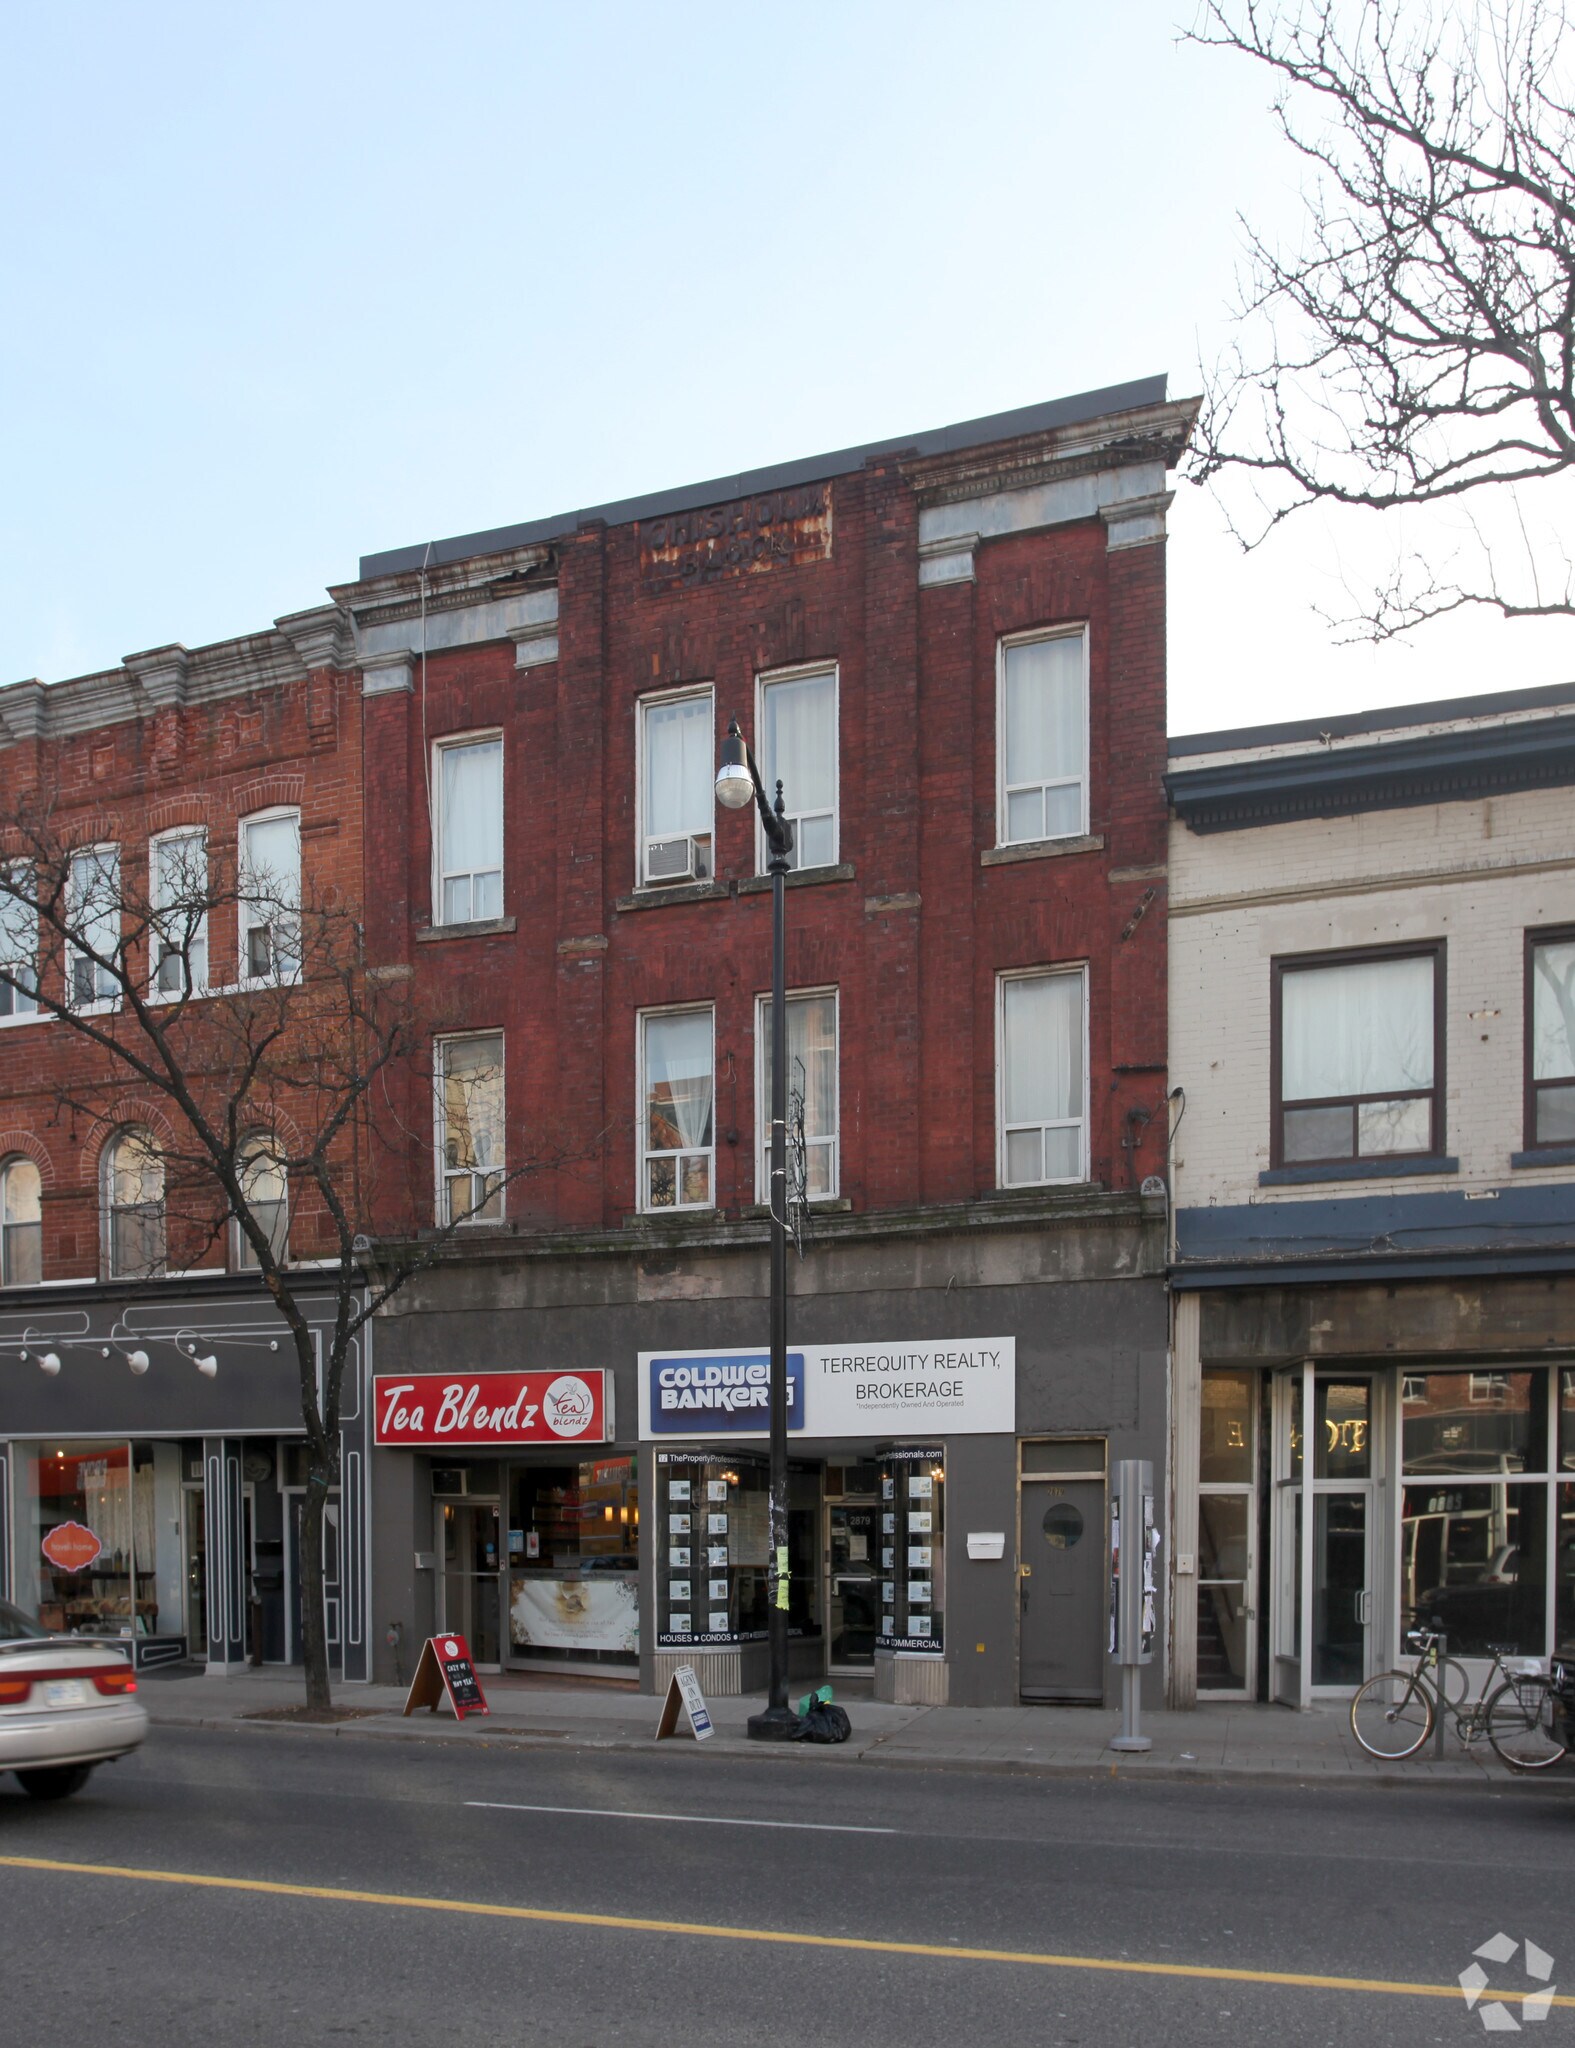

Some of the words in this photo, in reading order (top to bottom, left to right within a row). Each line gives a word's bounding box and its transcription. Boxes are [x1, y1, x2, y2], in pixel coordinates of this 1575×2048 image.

[820, 1354, 929, 1373] TERREQUITY
[934, 1351, 1001, 1370] REALTY,
[659, 1364, 795, 1388] COLDWE
[856, 1381, 964, 1400] BROKERAGE
[381, 1384, 424, 1434] Tea
[434, 1383, 539, 1433] Blendz
[553, 1416, 588, 1426] blendz
[850, 1516, 871, 1526] 2879
[660, 1634, 692, 1643] HOUSES
[701, 1633, 731, 1642] CONDOS
[891, 1639, 942, 1649] COMMERCIAL
